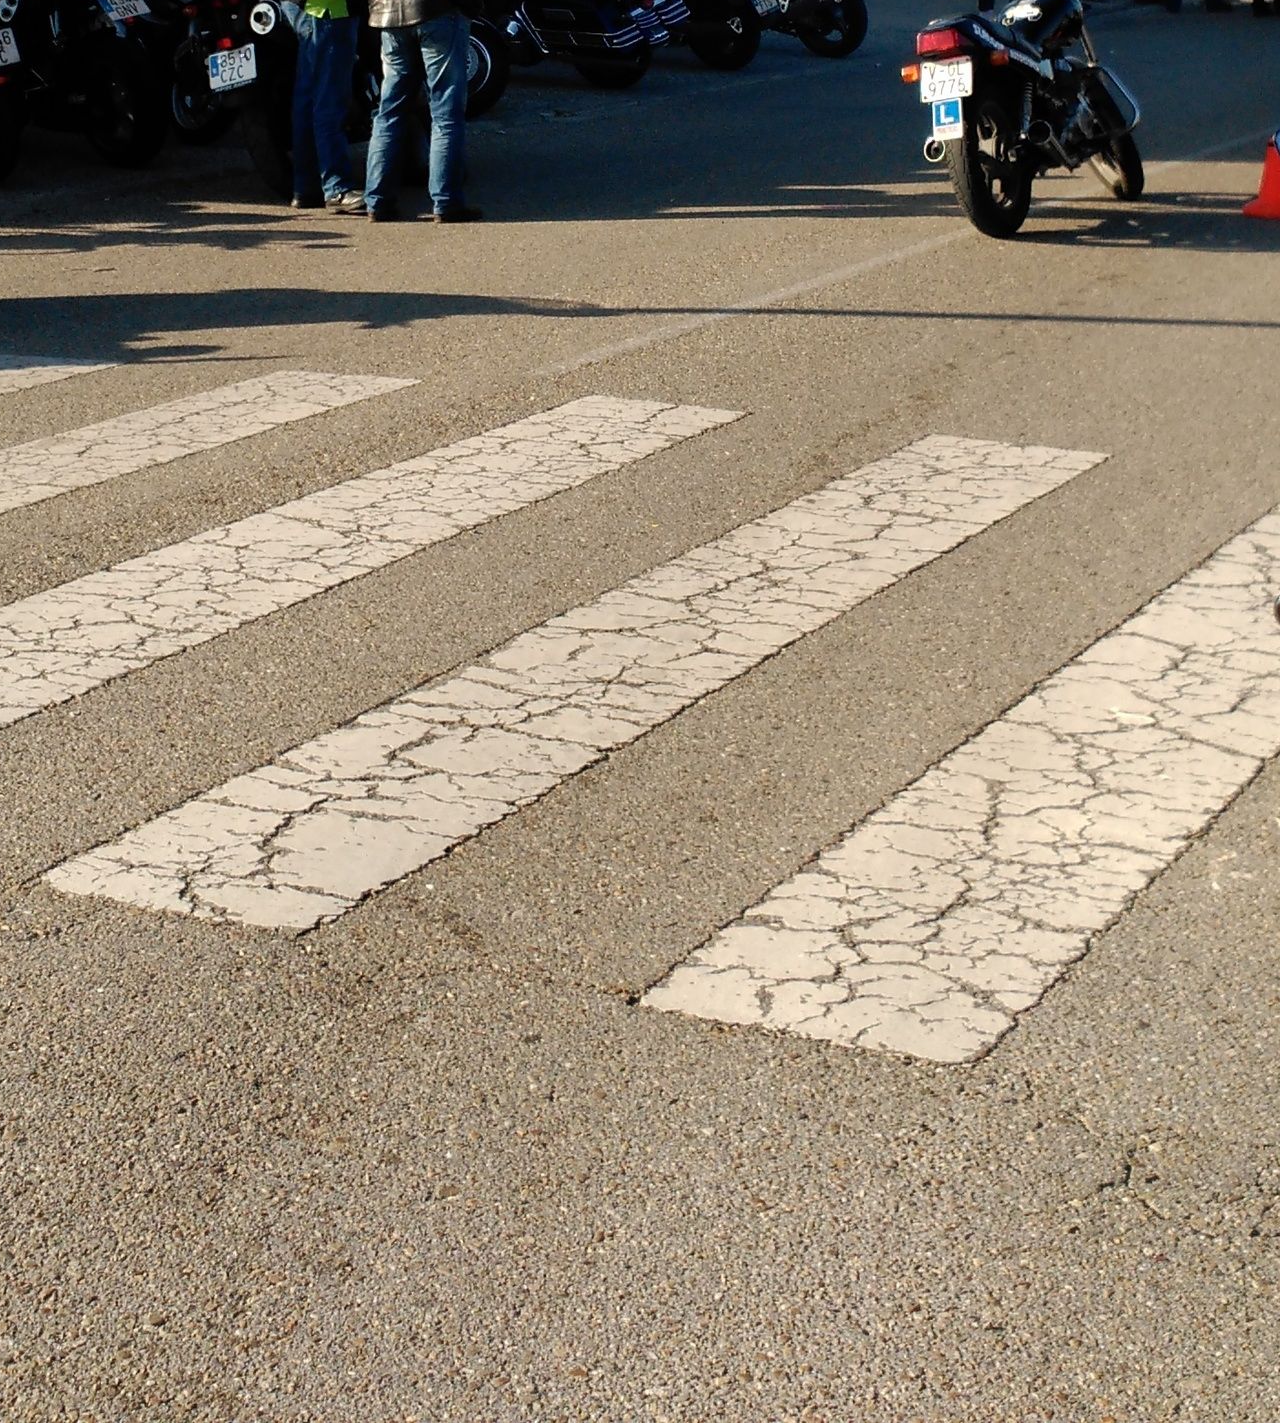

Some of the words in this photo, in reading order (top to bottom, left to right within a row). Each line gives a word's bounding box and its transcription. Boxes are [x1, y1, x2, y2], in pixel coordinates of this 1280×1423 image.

[115, 2, 138, 17] GNV
[220, 64, 245, 84] CZC
[927, 78, 967, 97] 9775
[939, 105, 955, 124] L
